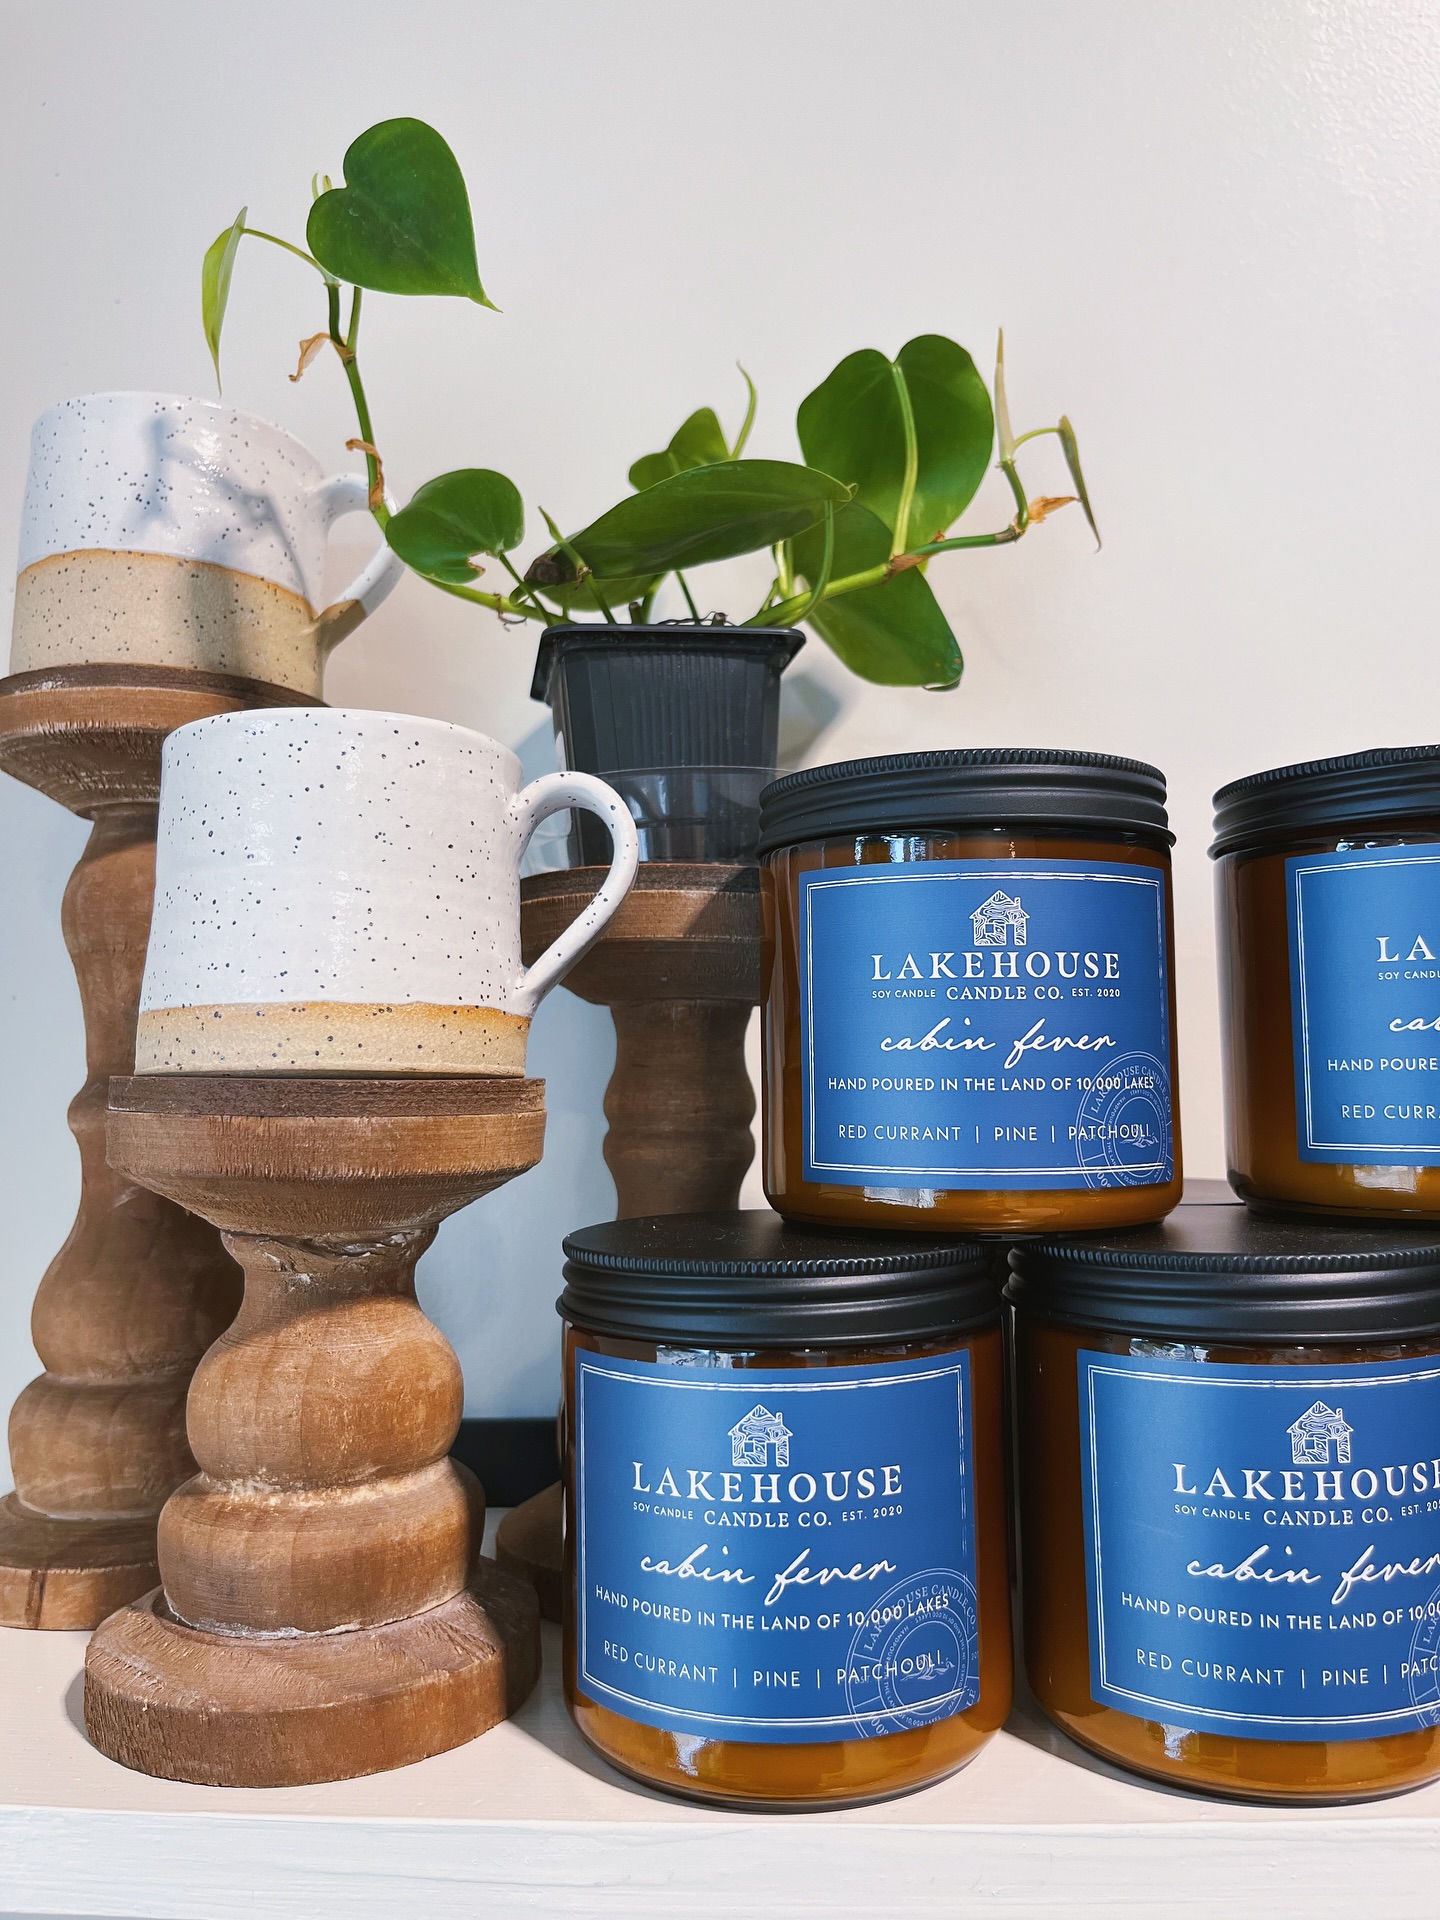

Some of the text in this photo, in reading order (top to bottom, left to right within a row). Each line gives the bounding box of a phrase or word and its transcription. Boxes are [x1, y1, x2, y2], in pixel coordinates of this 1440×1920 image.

[871, 951, 1120, 980] LAKEHOUSE
[1378, 971, 1400, 981] SOY
[872, 986, 1120, 1000] SOY CANDLE CANDLE CO. EST. 2020
[880, 1017, 1117, 1069] cabin fever
[1328, 1058, 1374, 1071] HAND
[828, 1076, 1154, 1093] HAND POURED IN THE LAND OF 10,000 LAKES
[1091, 1065, 1140, 1114] LAKOUSE
[1341, 1105, 1440, 1119] RED CURR
[839, 1124, 867, 1139] RED
[874, 1125, 961, 1141] CURRANT
[994, 1126, 1038, 1141] PINE
[1068, 1124, 1150, 1141] PATCHOULI
[632, 1461, 903, 1503] LAKEHOUSE
[633, 1501, 903, 1528] SOY CANDLE CANDLE CO. EST. 2020
[1174, 1504, 1197, 1516] SOY
[1202, 1507, 1251, 1521] CANDLE
[1263, 1509, 1354, 1526] CANDLE
[1361, 1507, 1393, 1524] CO.
[1401, 1504, 1422, 1516] EST.
[640, 1543, 897, 1606] cabin fever
[1186, 1544, 1322, 1584] cabin
[596, 1584, 949, 1630] HAND POURED IN THE LAND OF 10,000 LAKES
[863, 1585, 929, 1652] LAKOUSE
[1122, 1591, 1171, 1615] HAND
[1177, 1603, 1253, 1627] POURED
[1260, 1613, 1280, 1629] IN
[1286, 1615, 1322, 1630] THE
[1329, 1612, 1377, 1630] LAND
[1382, 1608, 1404, 1625] OF
[604, 1640, 629, 1662] RED
[634, 1652, 718, 1683] CURRANT
[753, 1670, 801, 1687] PINE
[837, 1648, 942, 1685] PATCHOULI
[1137, 1648, 1172, 1670] RED
[1181, 1659, 1284, 1686] CURRANT
[1322, 1668, 1369, 1686] PINE
